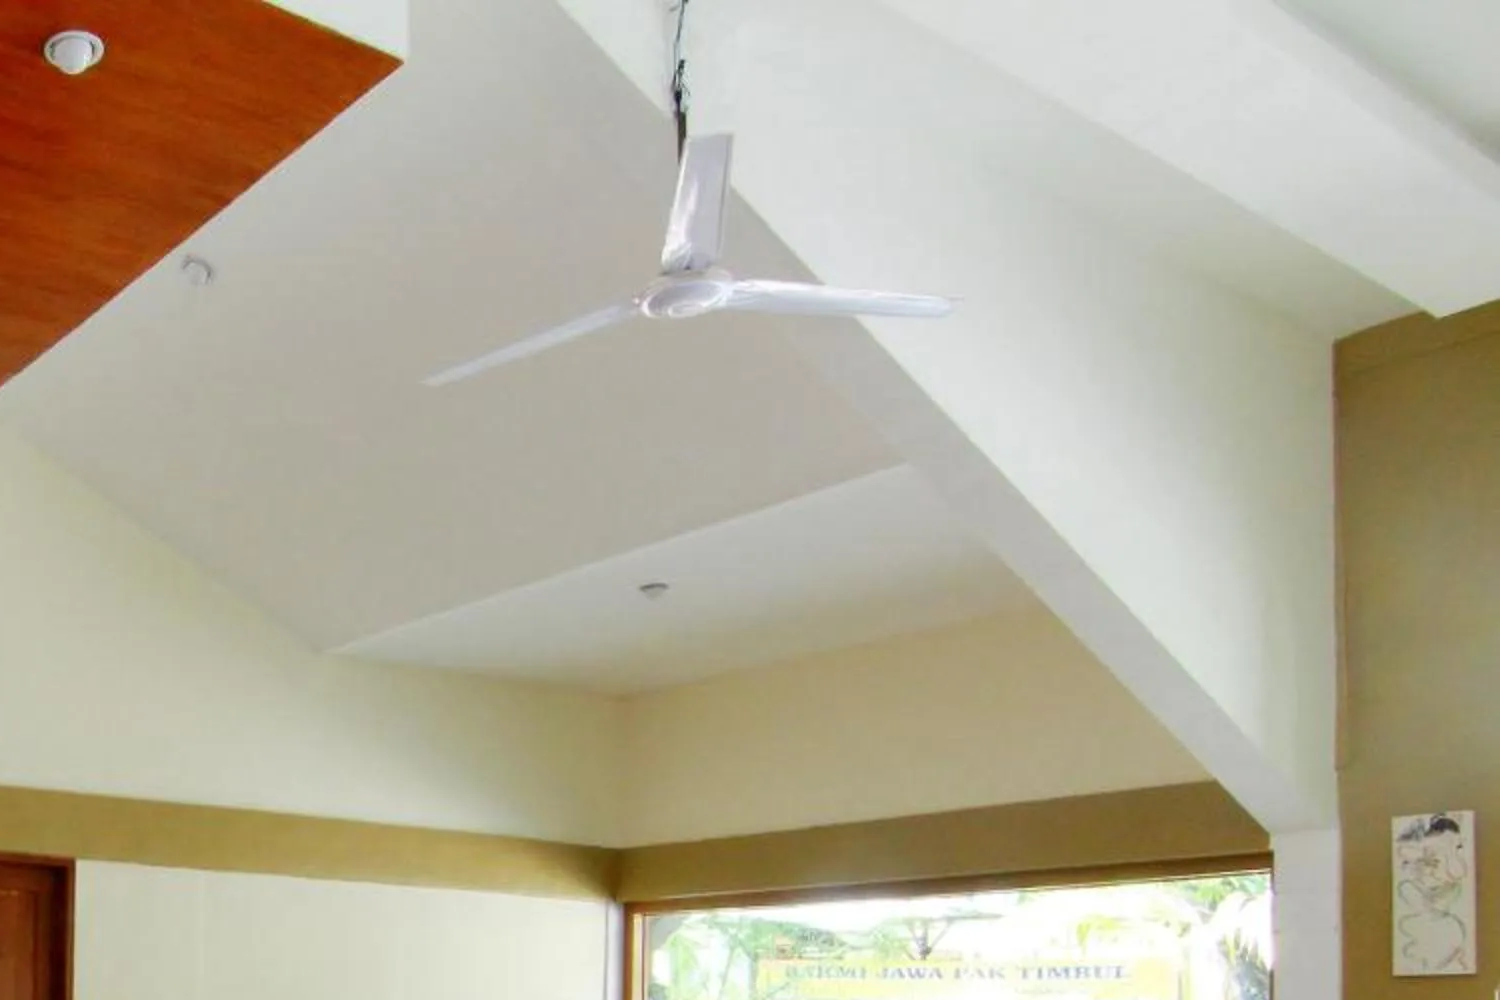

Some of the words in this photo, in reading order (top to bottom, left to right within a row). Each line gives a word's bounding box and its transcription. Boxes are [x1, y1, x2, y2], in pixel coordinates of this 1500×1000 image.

[876, 964, 944, 980] JAWA
[953, 964, 1005, 980] PAK
[1017, 964, 1130, 980] TIMBUL
